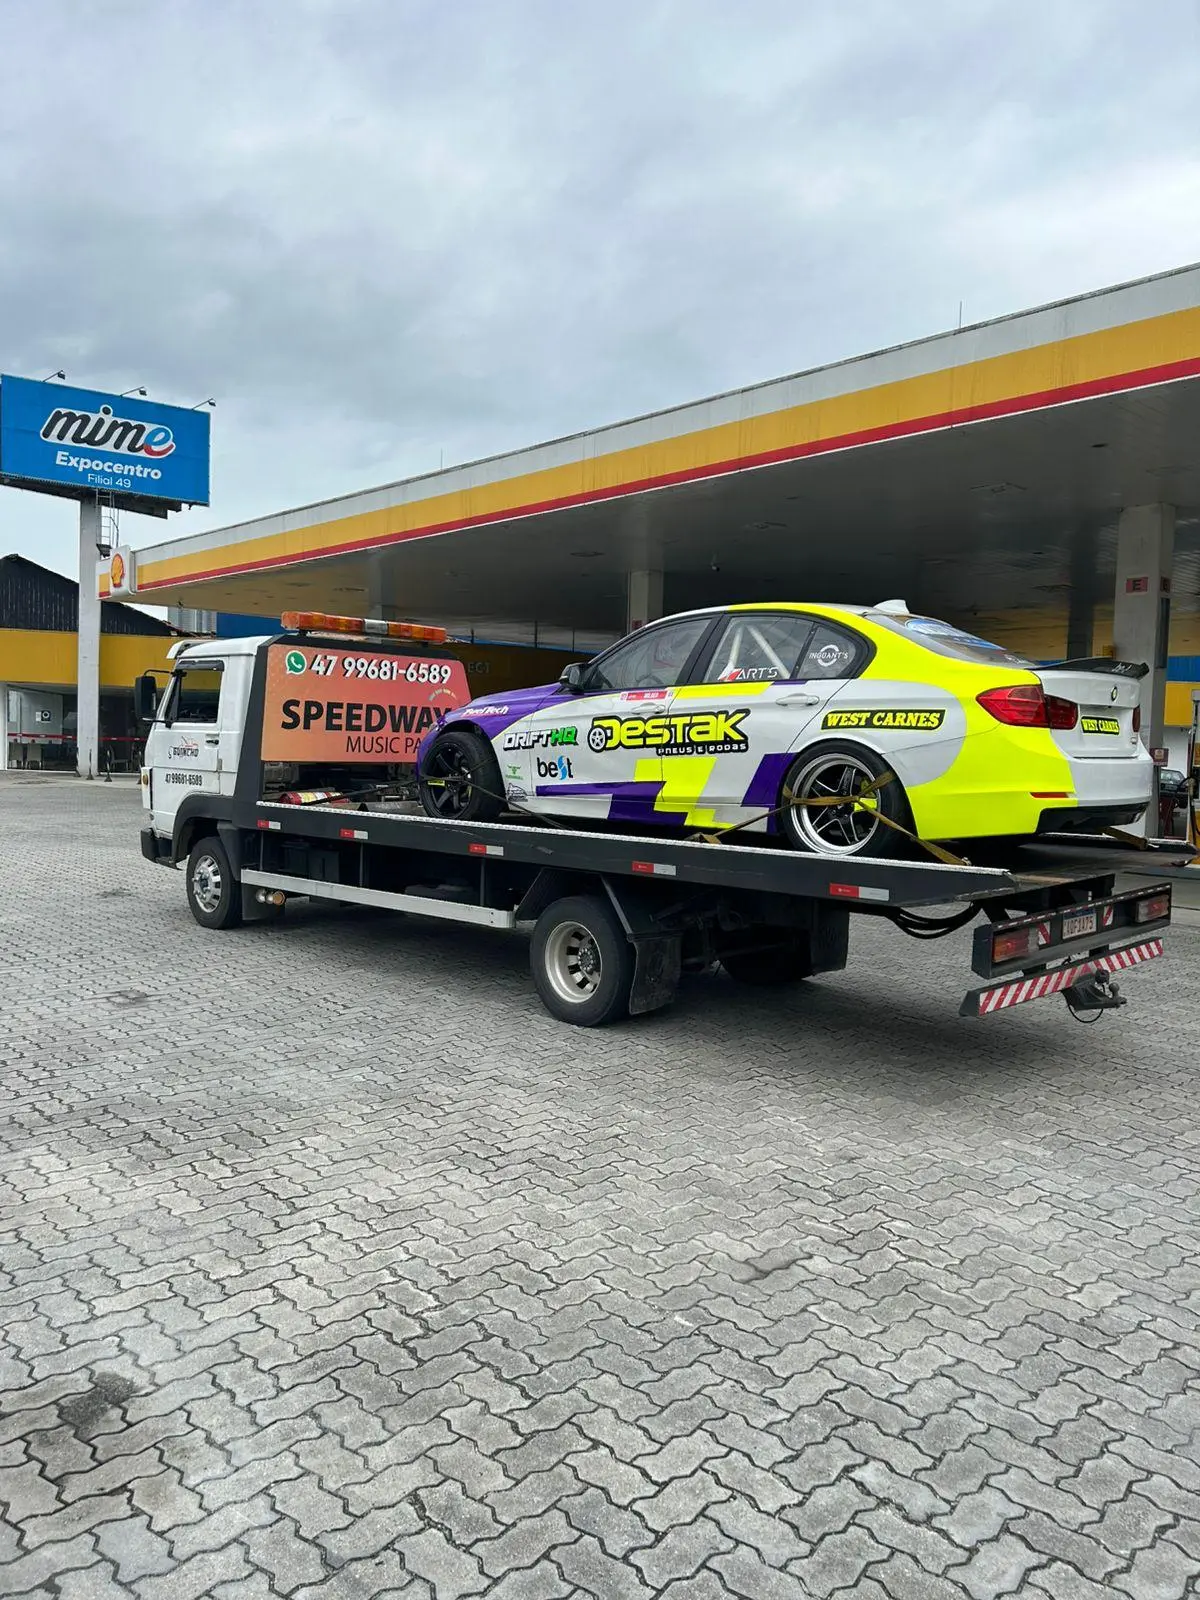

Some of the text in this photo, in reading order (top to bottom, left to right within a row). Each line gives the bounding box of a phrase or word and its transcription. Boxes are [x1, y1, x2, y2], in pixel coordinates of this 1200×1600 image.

[41, 405, 175, 458] mime
[56, 451, 162, 479] Expocentro
[88, 474, 132, 488] Filial 49
[311, 654, 451, 684] 47 99681-6589
[827, 712, 940, 728] WEST CARNES
[346, 736, 400, 754] MUSIC
[536, 755, 574, 780] best
